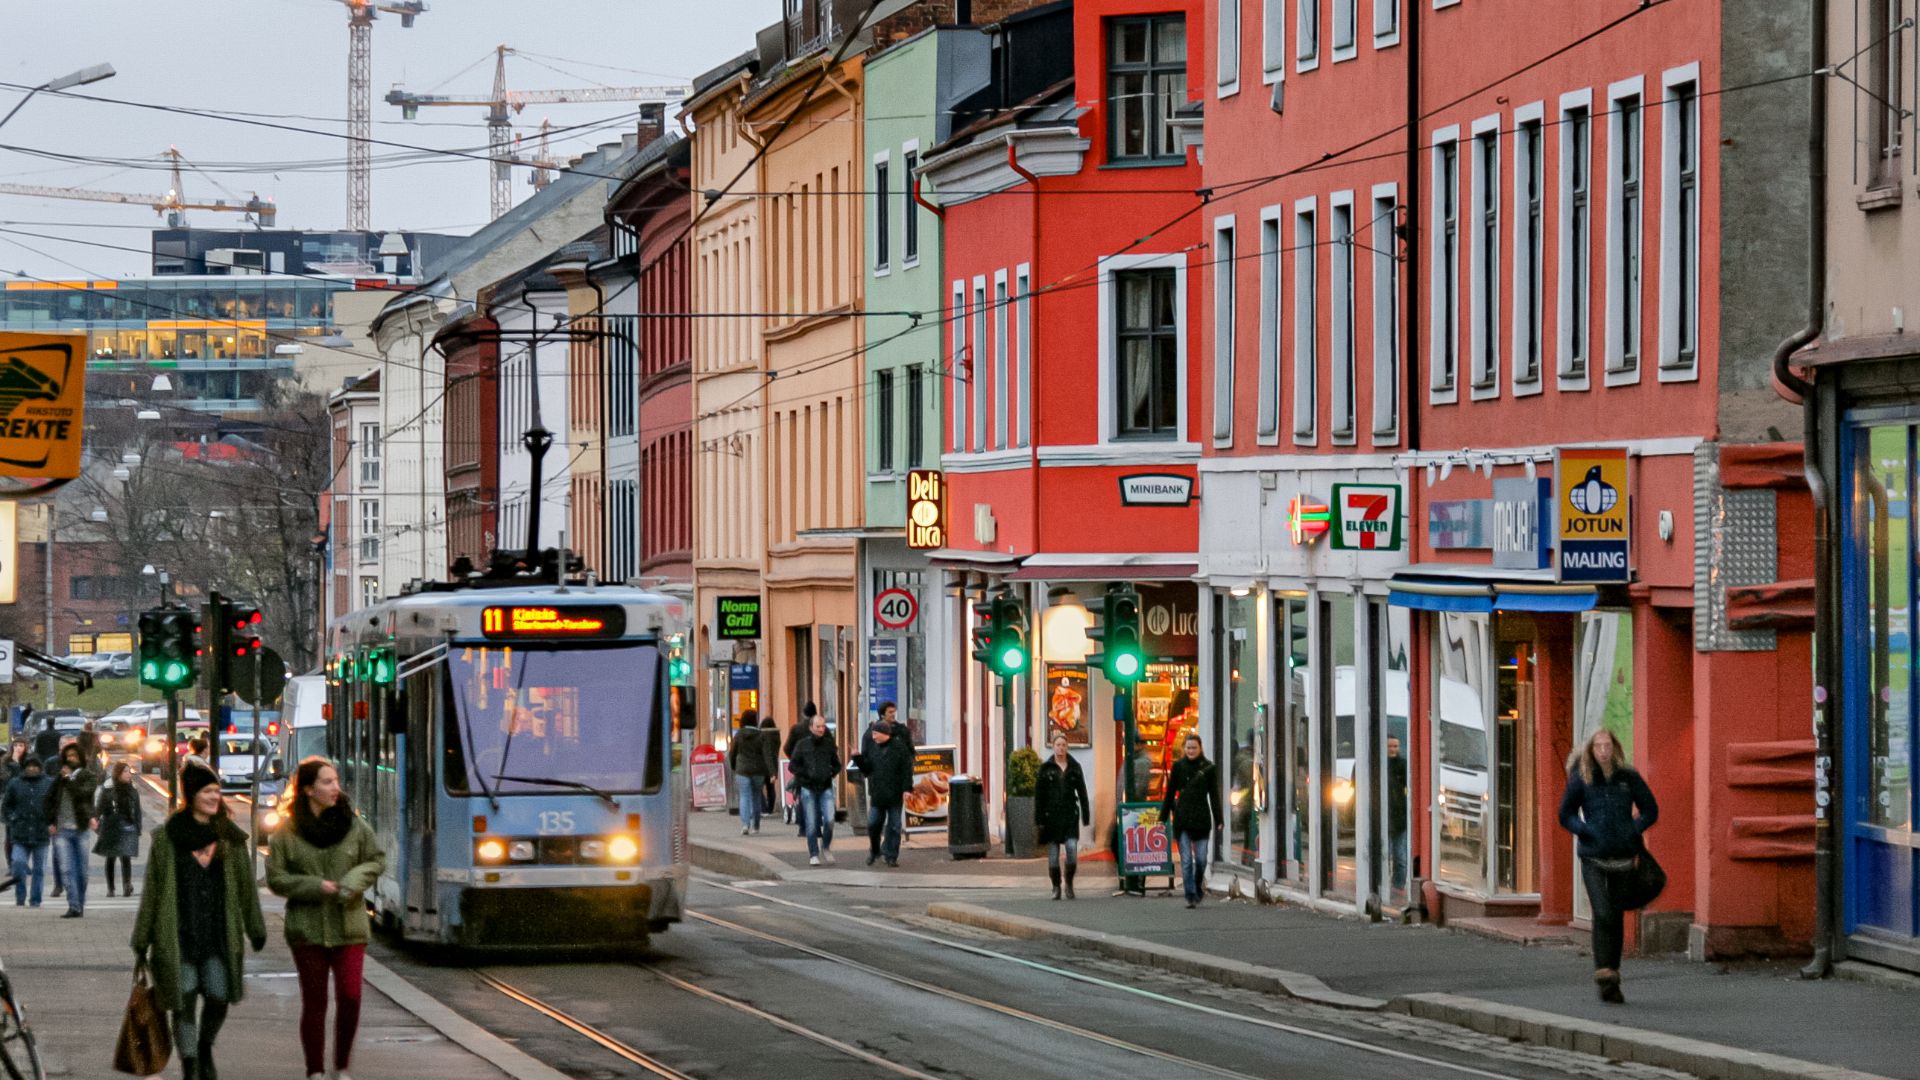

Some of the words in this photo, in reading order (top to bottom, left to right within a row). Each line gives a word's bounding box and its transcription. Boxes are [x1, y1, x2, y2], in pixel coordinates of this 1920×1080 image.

[910, 471, 939, 500] Deli
[1130, 484, 1184, 495] MINIBANK
[1347, 494, 1388, 550] 7
[1565, 517, 1623, 533] JOTUN
[909, 518, 941, 547] Luca
[1563, 551, 1625, 569] MALING
[721, 600, 758, 613] Noma
[881, 599, 910, 618] 40
[484, 607, 503, 632] 11
[726, 614, 754, 627] Grill
[538, 811, 576, 833] 135
[1125, 824, 1168, 853] 116
